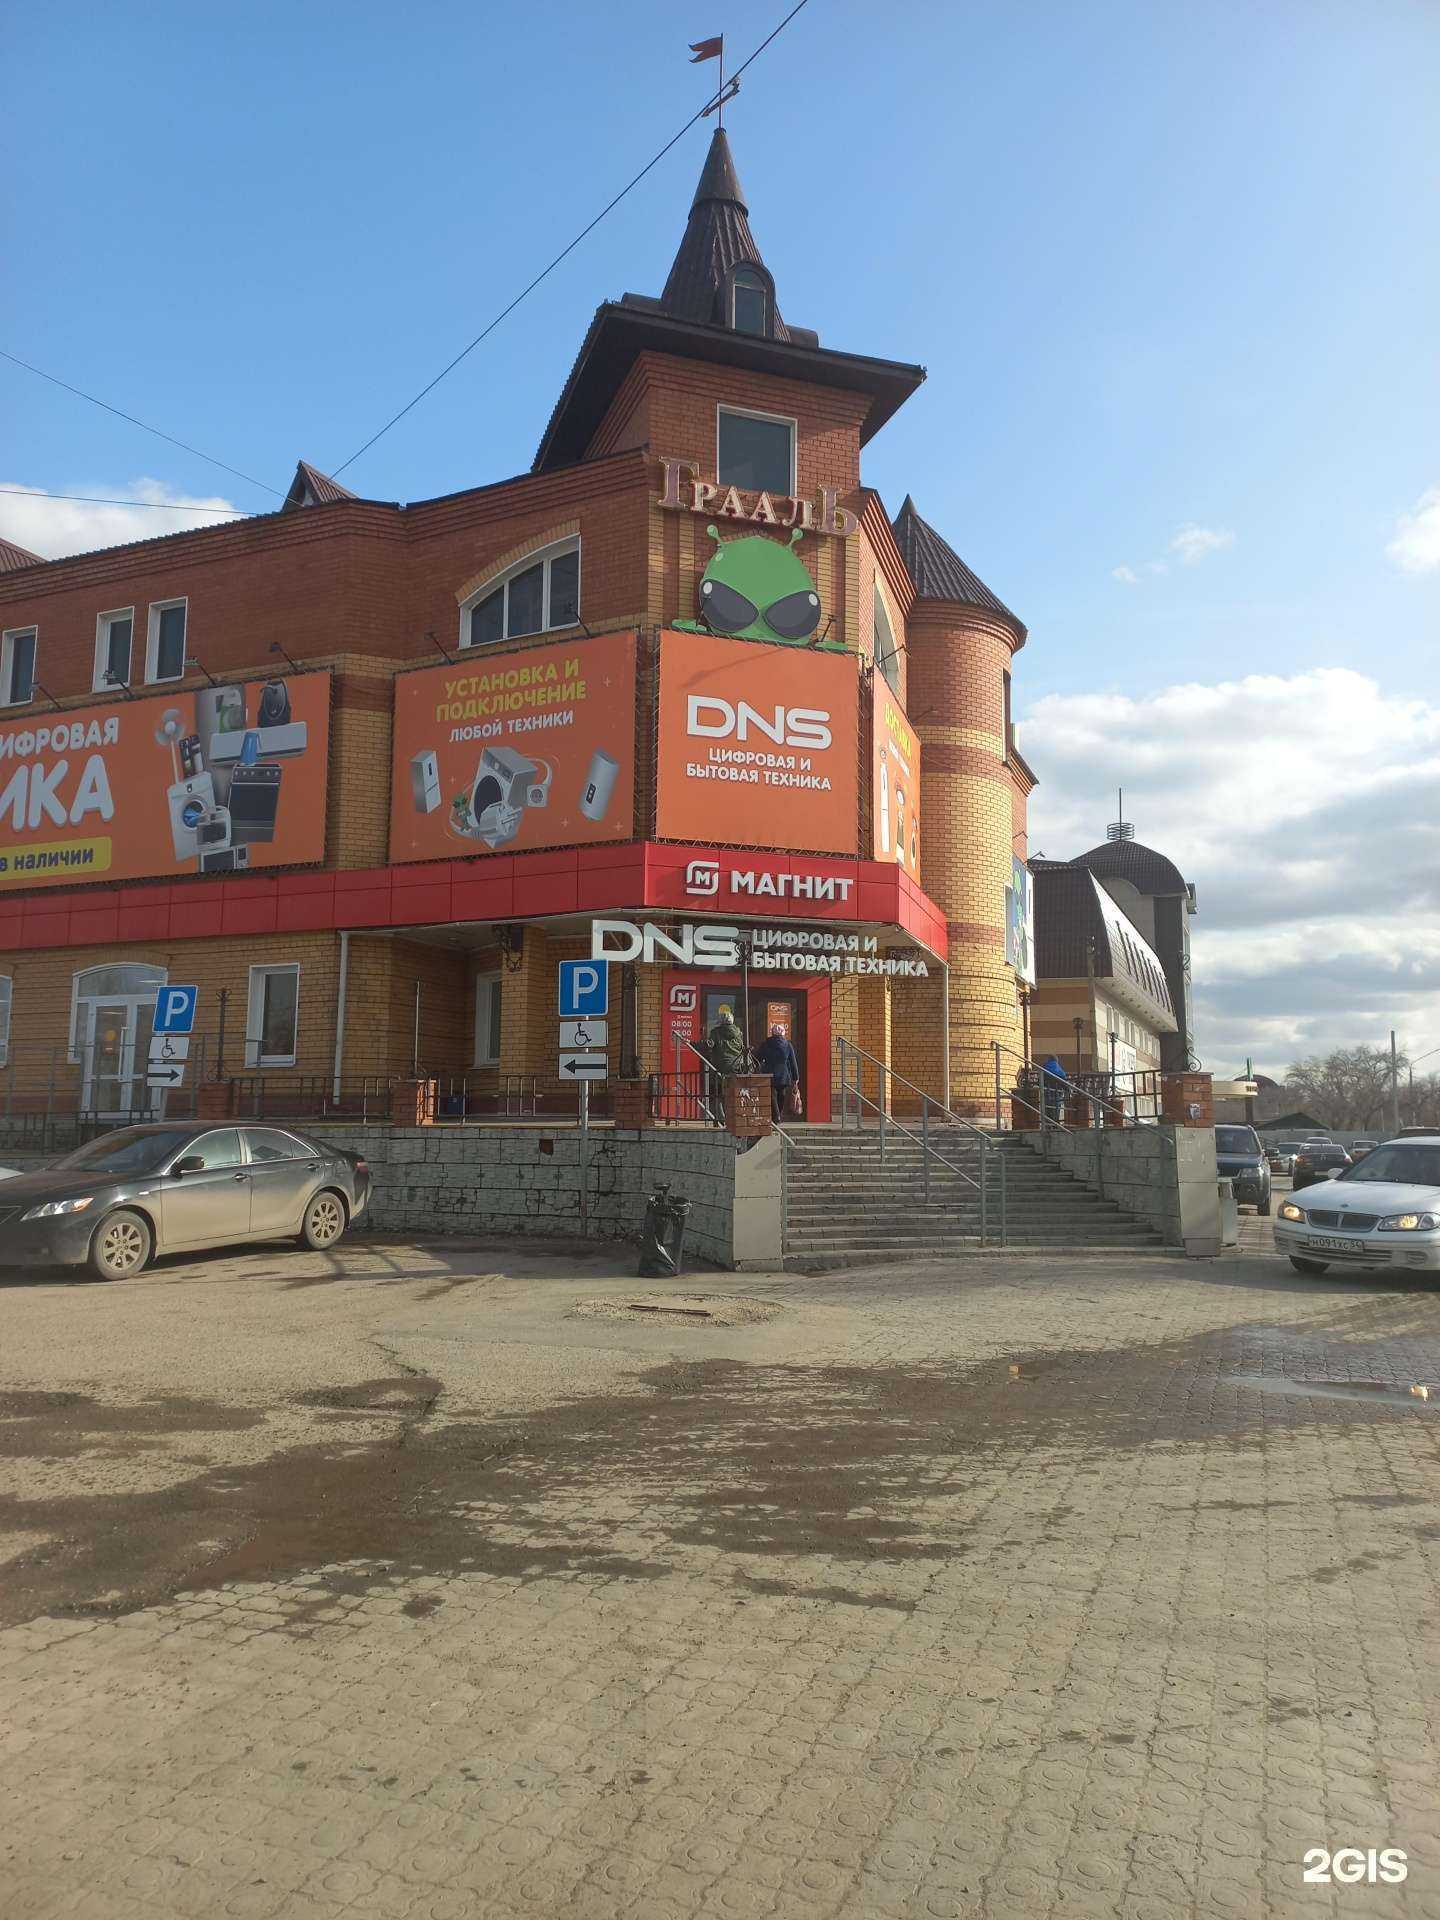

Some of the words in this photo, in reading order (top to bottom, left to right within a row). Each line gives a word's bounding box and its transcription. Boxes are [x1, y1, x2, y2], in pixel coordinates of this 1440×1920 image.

[444, 664, 558, 699] УСТАНОВКА
[565, 658, 580, 678] И
[435, 681, 587, 722] ПОДКЛЮЧЕНИЕ
[449, 719, 503, 743] ЛЮБОЙ
[507, 710, 574, 733] ТЕХНИКИ
[686, 694, 833, 750] DNS
[709, 748, 795, 769] ЦИФРОВАЯ
[800, 757, 811, 771] И
[686, 763, 759, 784] БЫТОВАЯ
[763, 770, 832, 791] ТЕХНИКА
[14, 847, 94, 871] наличии
[730, 870, 854, 901] МАГНИТ
[591, 919, 740, 967] DNS
[753, 928, 859, 953] ЦИФРОВАЯ
[864, 935, 878, 952] И
[752, 951, 841, 973] БЫТОВАЯ
[845, 955, 929, 978] ТЕХНИКА
[573, 966, 599, 1009] P
[164, 991, 189, 1027] P
